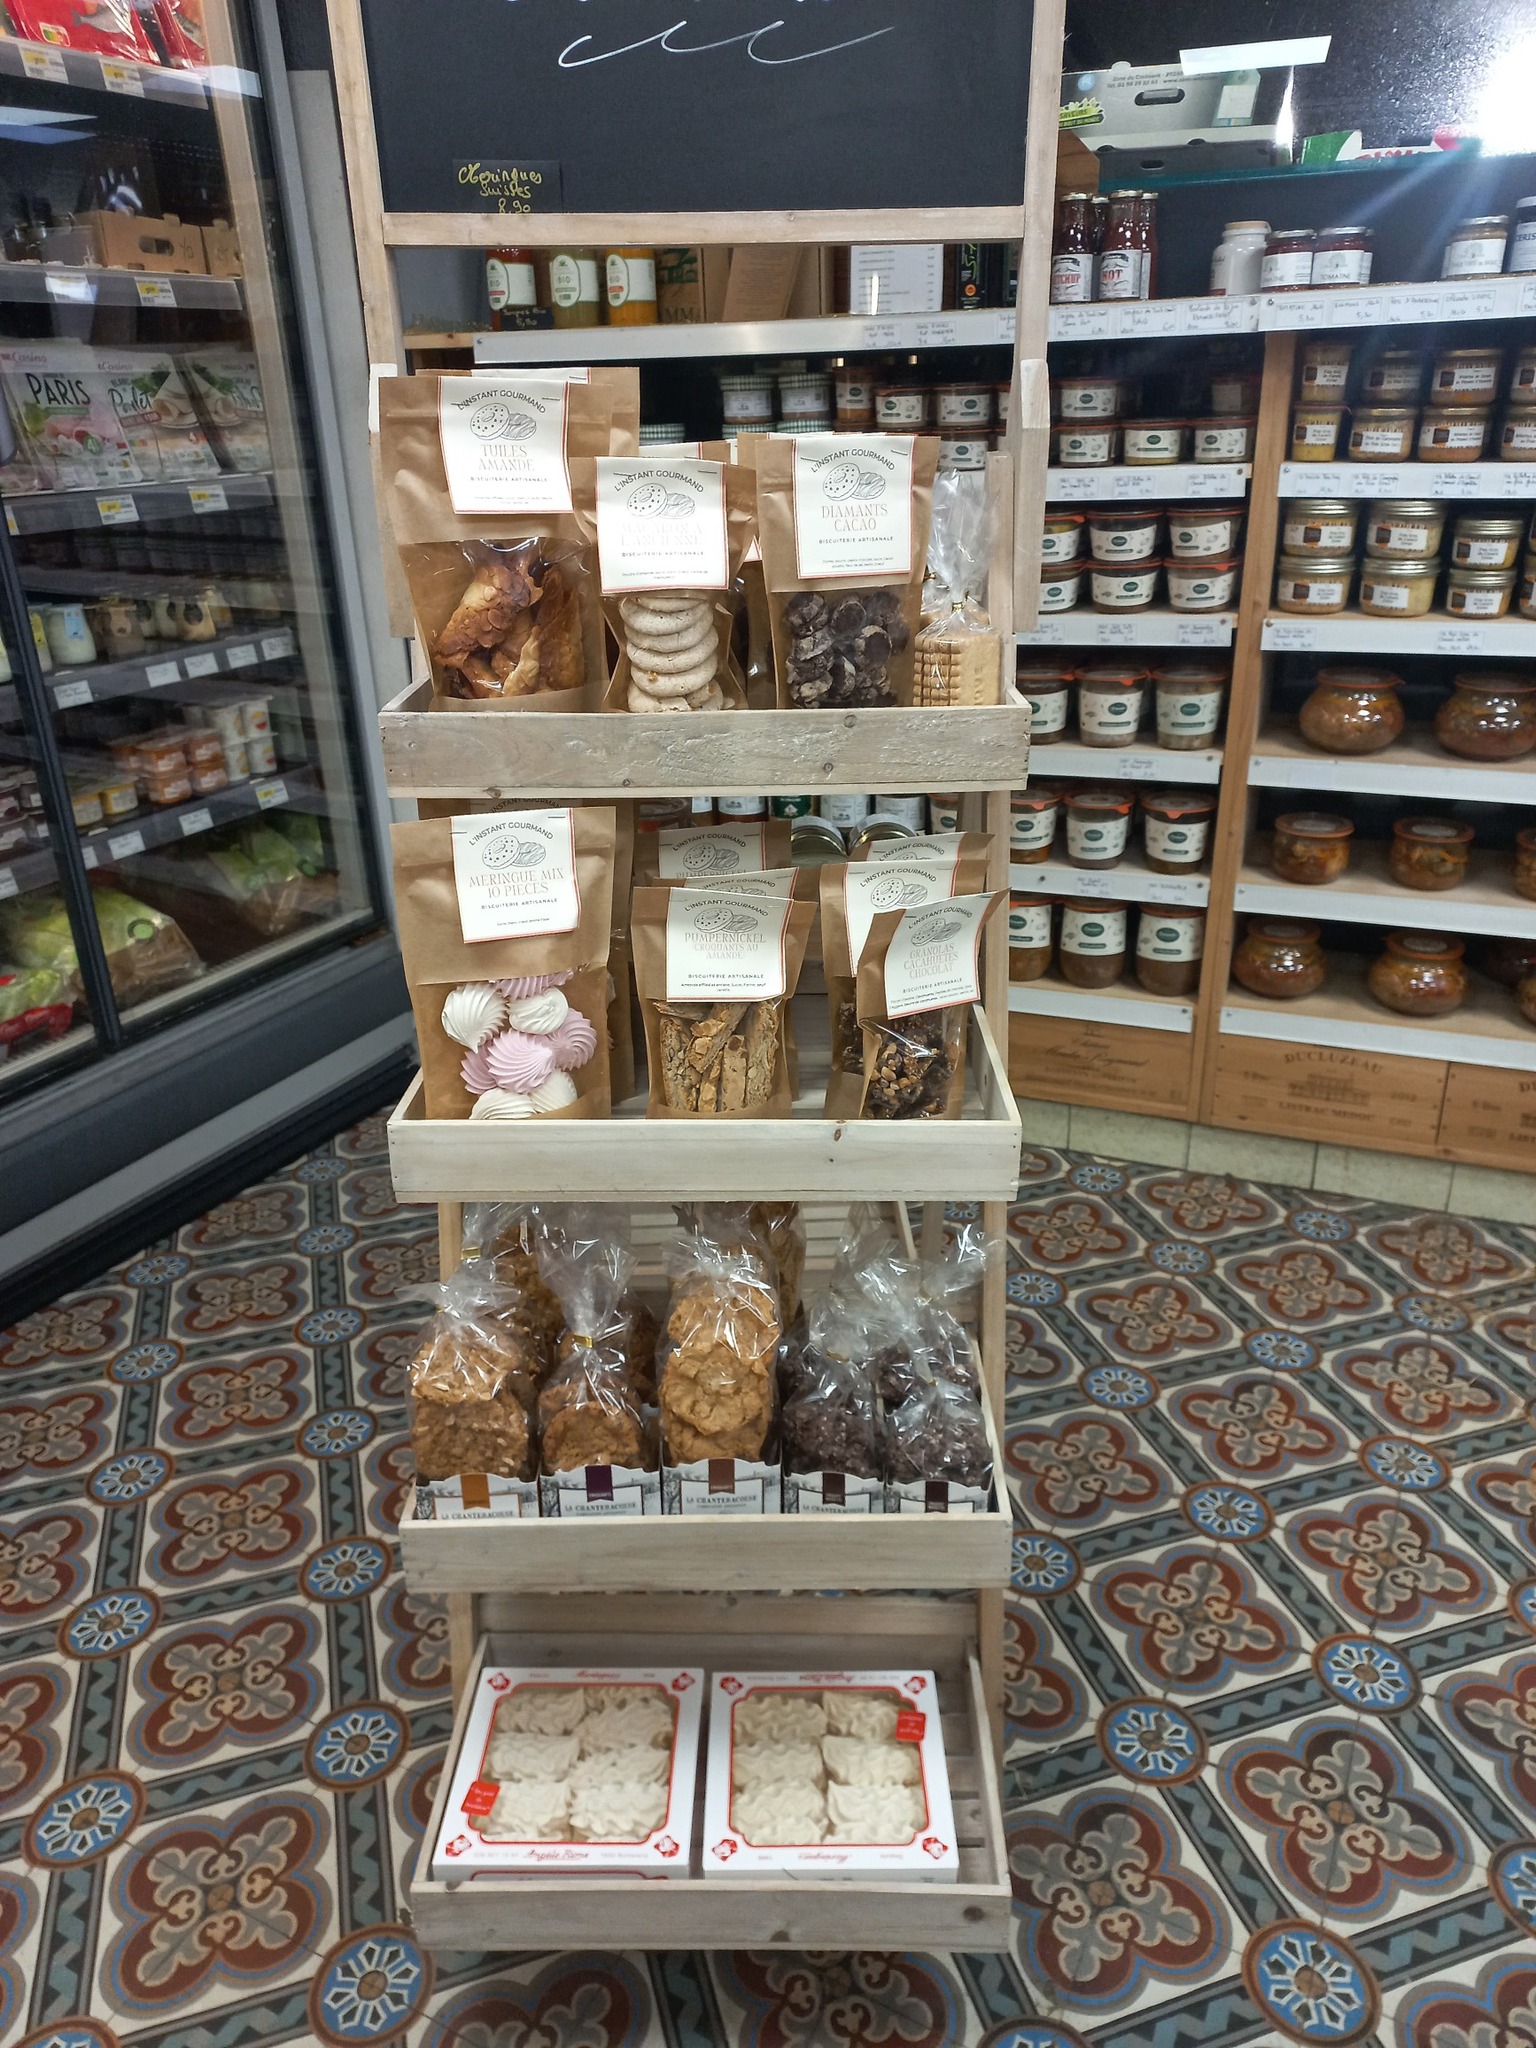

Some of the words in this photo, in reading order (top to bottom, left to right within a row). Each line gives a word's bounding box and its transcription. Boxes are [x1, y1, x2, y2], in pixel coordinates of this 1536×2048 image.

[26, 372, 91, 406] PARIS
[457, 390, 498, 410] L'INSTANT
[500, 389, 546, 413] GOURMAND
[480, 444, 528, 457] TUILES
[478, 458, 535, 472] AMANDE
[810, 449, 850, 473] L'INSTANT
[851, 448, 895, 471] GOURMAND
[614, 470, 654, 492] L'INSTANT
[656, 469, 704, 493] GOURMAND
[821, 504, 888, 519] DIAMANTS
[834, 518, 877, 532] CACAO
[468, 823, 507, 846] L'INSTANT
[508, 821, 554, 840] GOURMAND
[672, 834, 706, 851] L'INSTANT
[707, 832, 747, 848] GOURMAND
[912, 842, 945, 855] GOURMAND
[469, 869, 538, 887] MERINGUE
[541, 867, 565, 880] MIX
[736, 878, 776, 888] GOURMAND
[860, 868, 895, 887] L'INSTANT
[897, 867, 937, 882] GOURMAND
[488, 886, 501, 898] 10
[505, 882, 549, 897] PIECES
[481, 902, 519, 910] BISCUITERIE
[521, 898, 558, 906] ARTISANALE
[684, 899, 724, 912] L'INSTANT
[725, 899, 769, 917] GOURMAND
[908, 909, 943, 930] L'INSTANT
[943, 906, 973, 919] GOURMAND
[685, 932, 767, 944] PUMPERNICKEL
[909, 943, 955, 959] GRANOLAS
[909, 963, 954, 980] CHOCOLAT
[902, 983, 933, 993] BISCUITERIE
[934, 977, 963, 988] ARTISANALE
[1284, 1051, 1383, 1075] DUCLUZEAU
